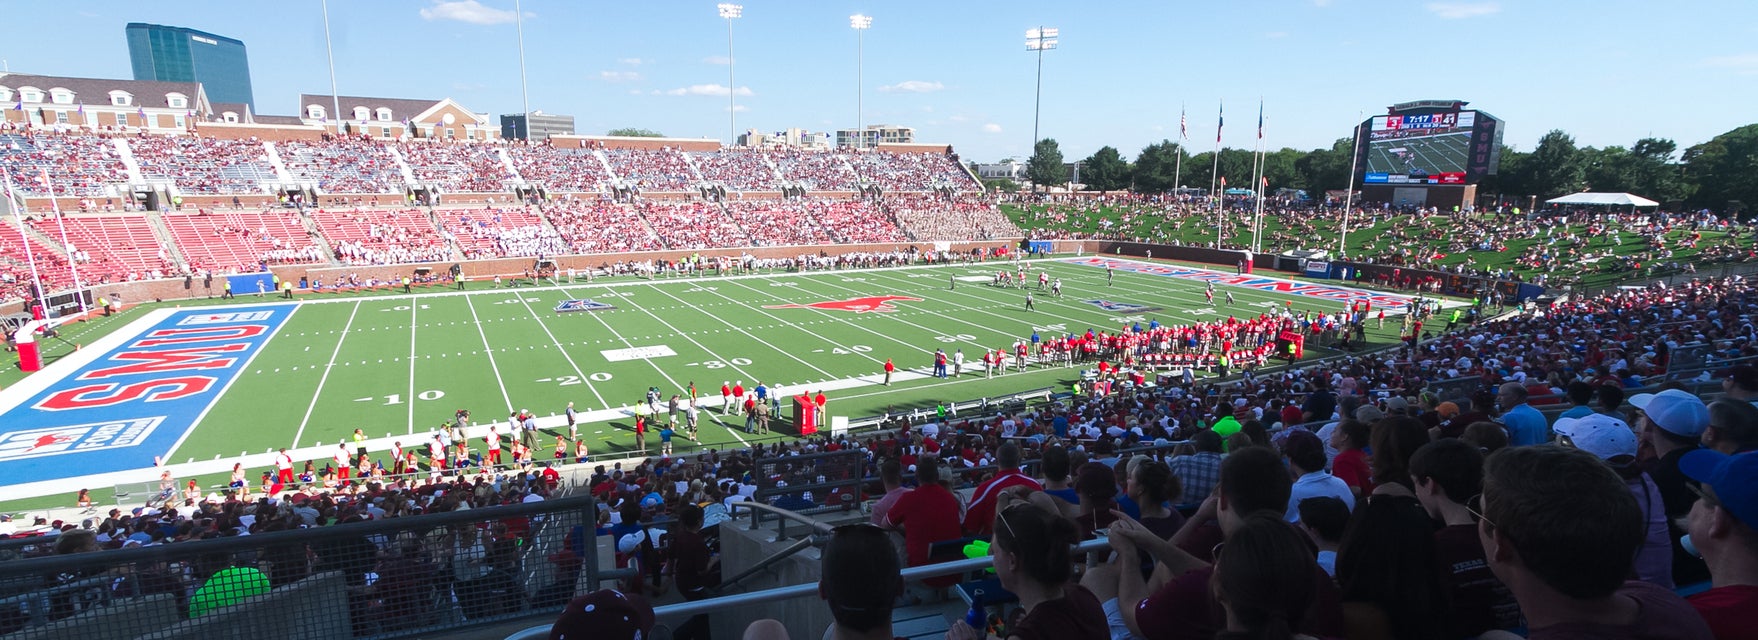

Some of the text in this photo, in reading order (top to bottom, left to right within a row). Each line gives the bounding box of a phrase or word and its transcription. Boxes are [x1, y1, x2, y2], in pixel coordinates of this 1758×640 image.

[1391, 119, 1398, 127] 3
[1409, 115, 1430, 124] 7:17
[1443, 116, 1455, 124] 41
[934, 333, 977, 343] 50
[832, 344, 873, 355] 40
[31, 325, 269, 411] SMU
[702, 357, 753, 369] 30
[555, 371, 613, 387] 20
[383, 389, 445, 406] 10
[75, 423, 126, 449] FORD
